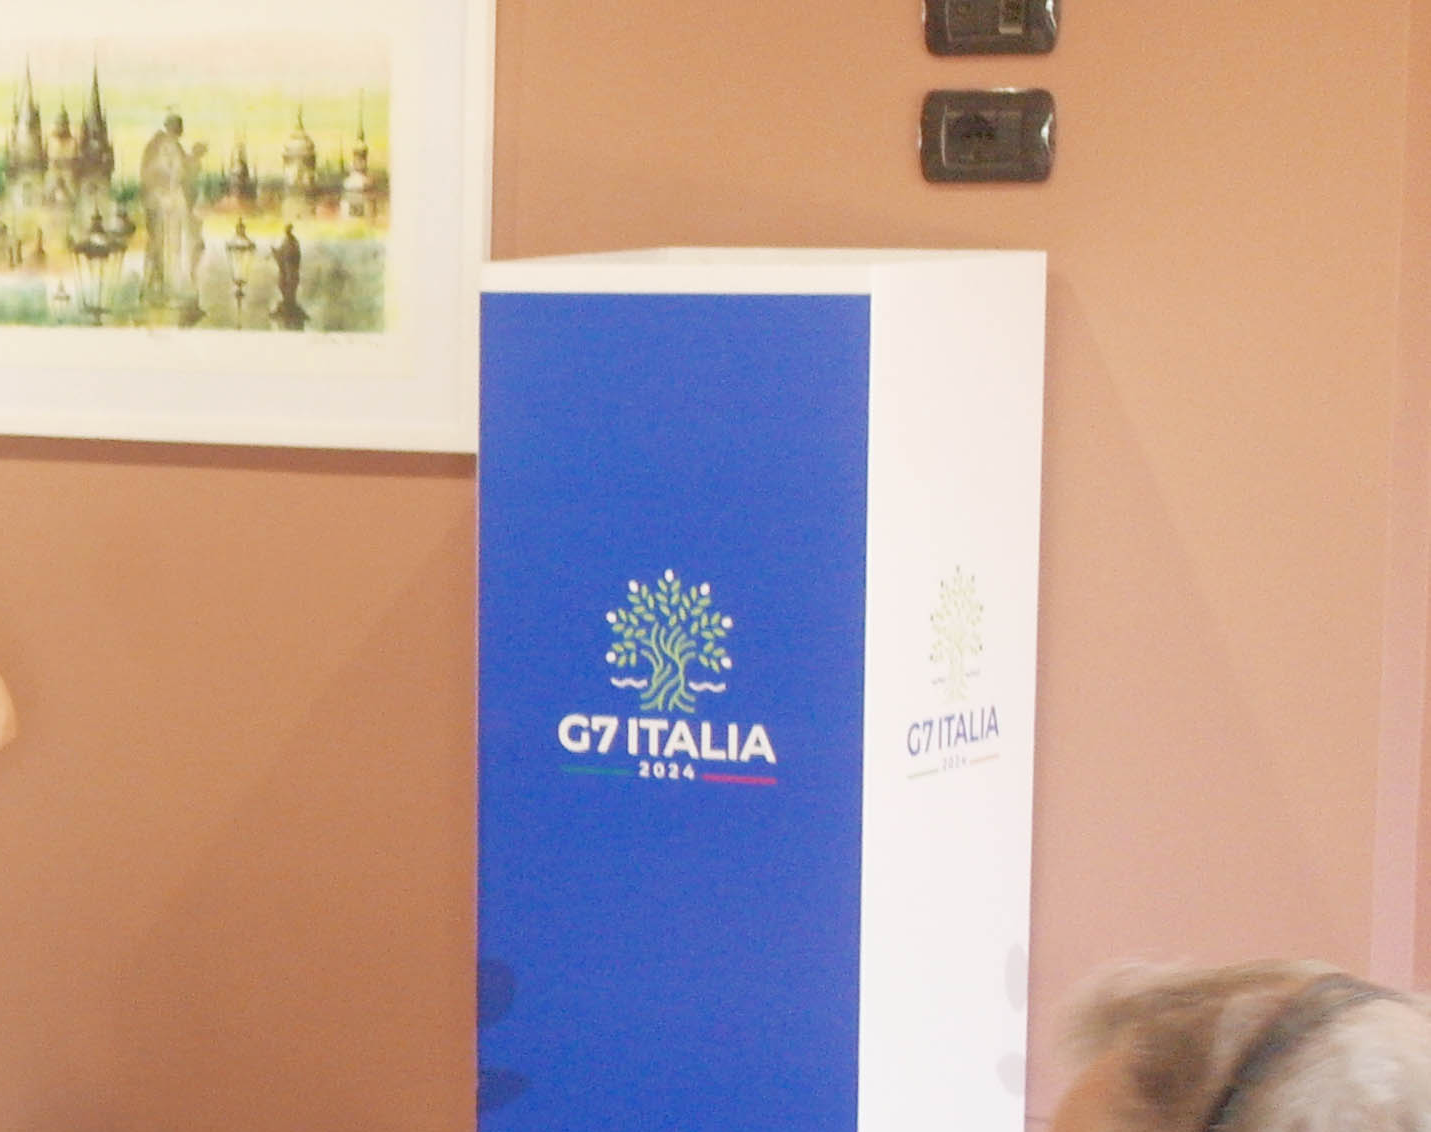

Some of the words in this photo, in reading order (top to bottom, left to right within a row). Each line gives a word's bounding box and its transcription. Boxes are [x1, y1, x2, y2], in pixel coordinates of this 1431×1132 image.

[558, 713, 619, 754] G7
[627, 716, 777, 764] ITALIA
[907, 718, 934, 757] G7
[938, 703, 1000, 751] ITALIA
[638, 760, 695, 780] 2024
